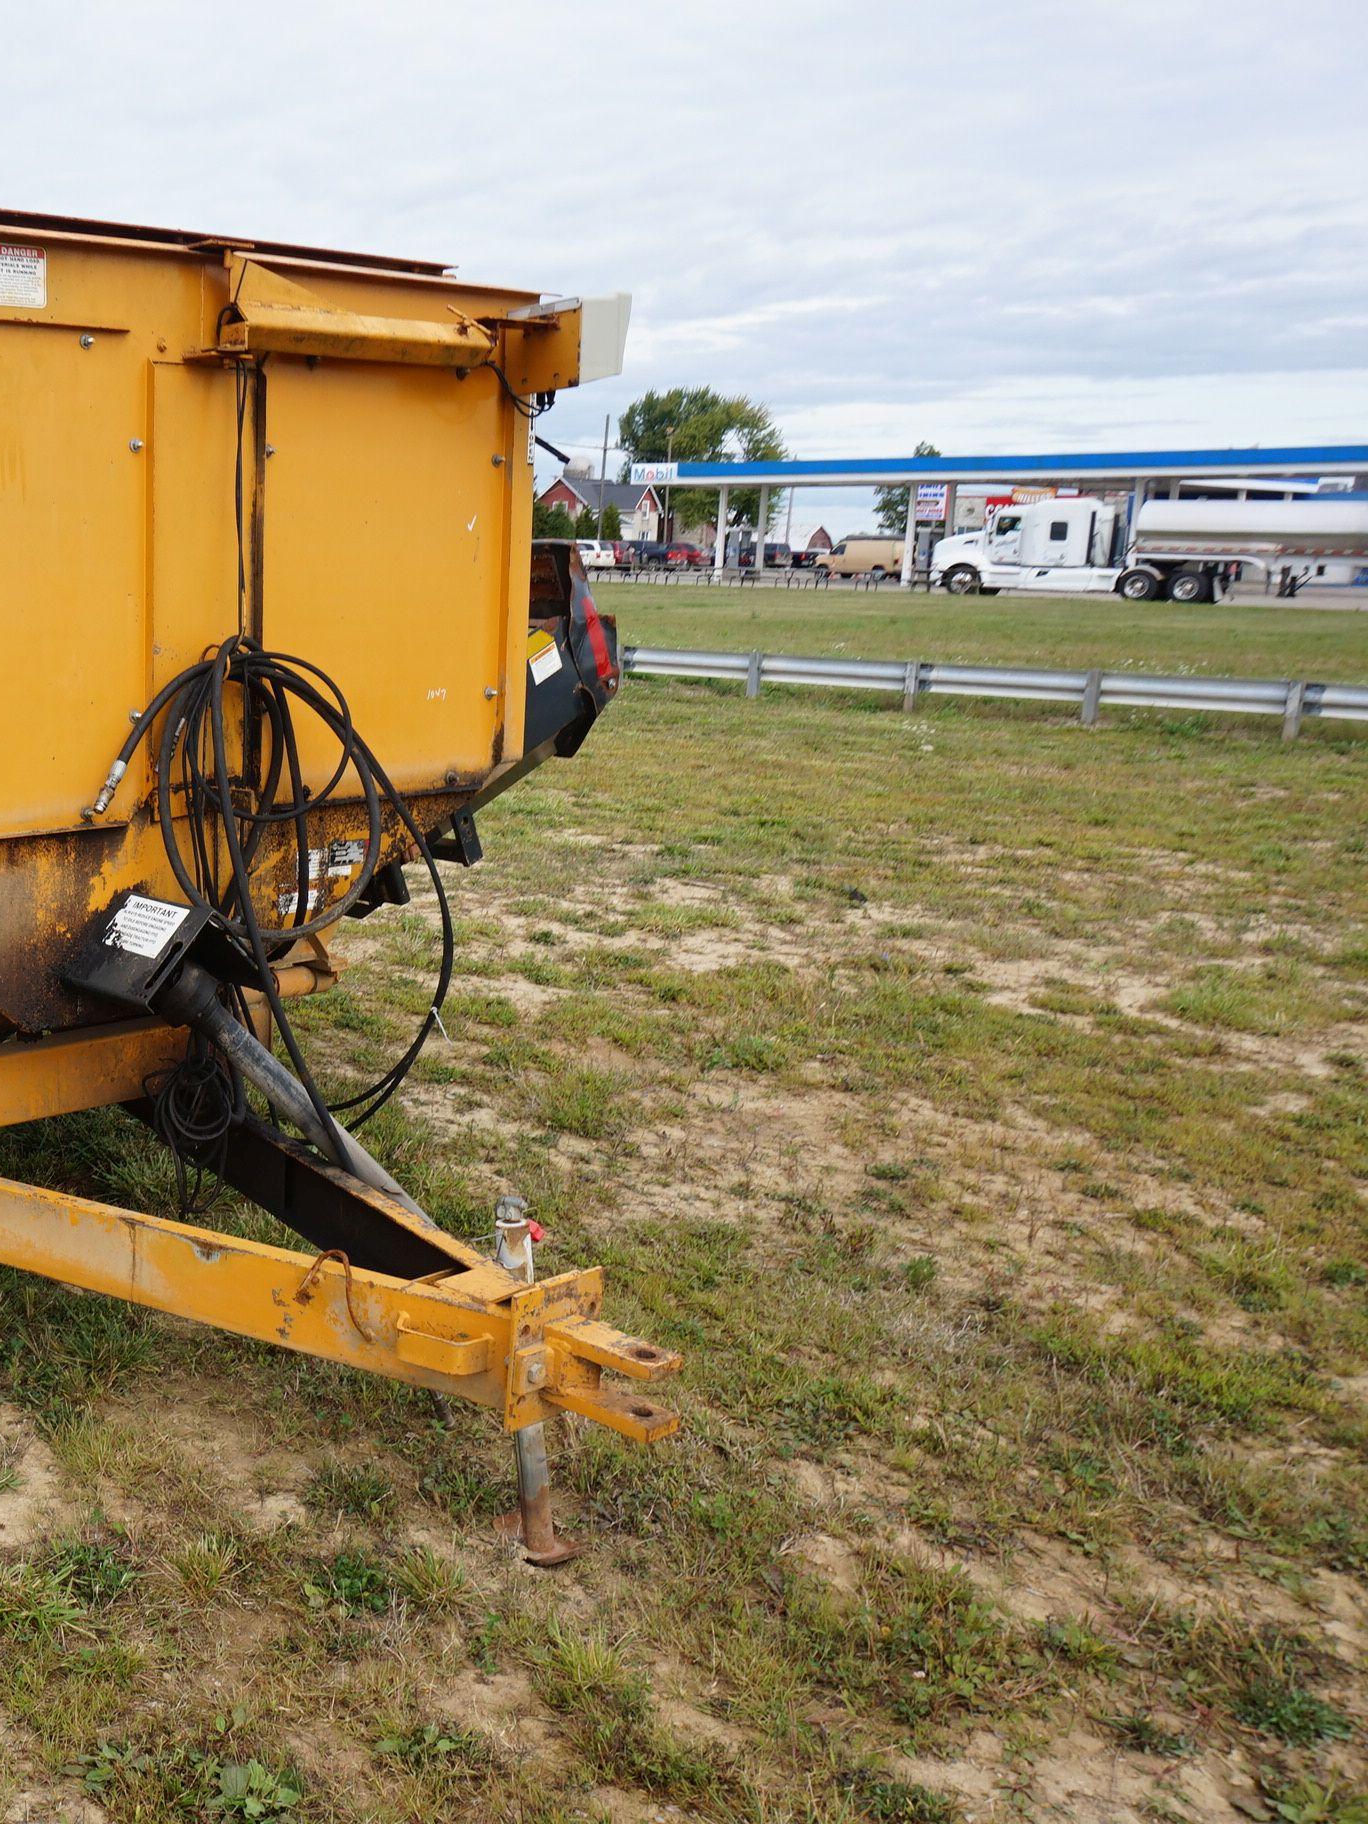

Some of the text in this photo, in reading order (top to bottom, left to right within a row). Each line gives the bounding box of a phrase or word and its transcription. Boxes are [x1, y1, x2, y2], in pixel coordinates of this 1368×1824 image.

[1, 246, 38, 258] DANGER
[633, 466, 674, 481] Mobil
[132, 901, 178, 919] IMPORTANT
